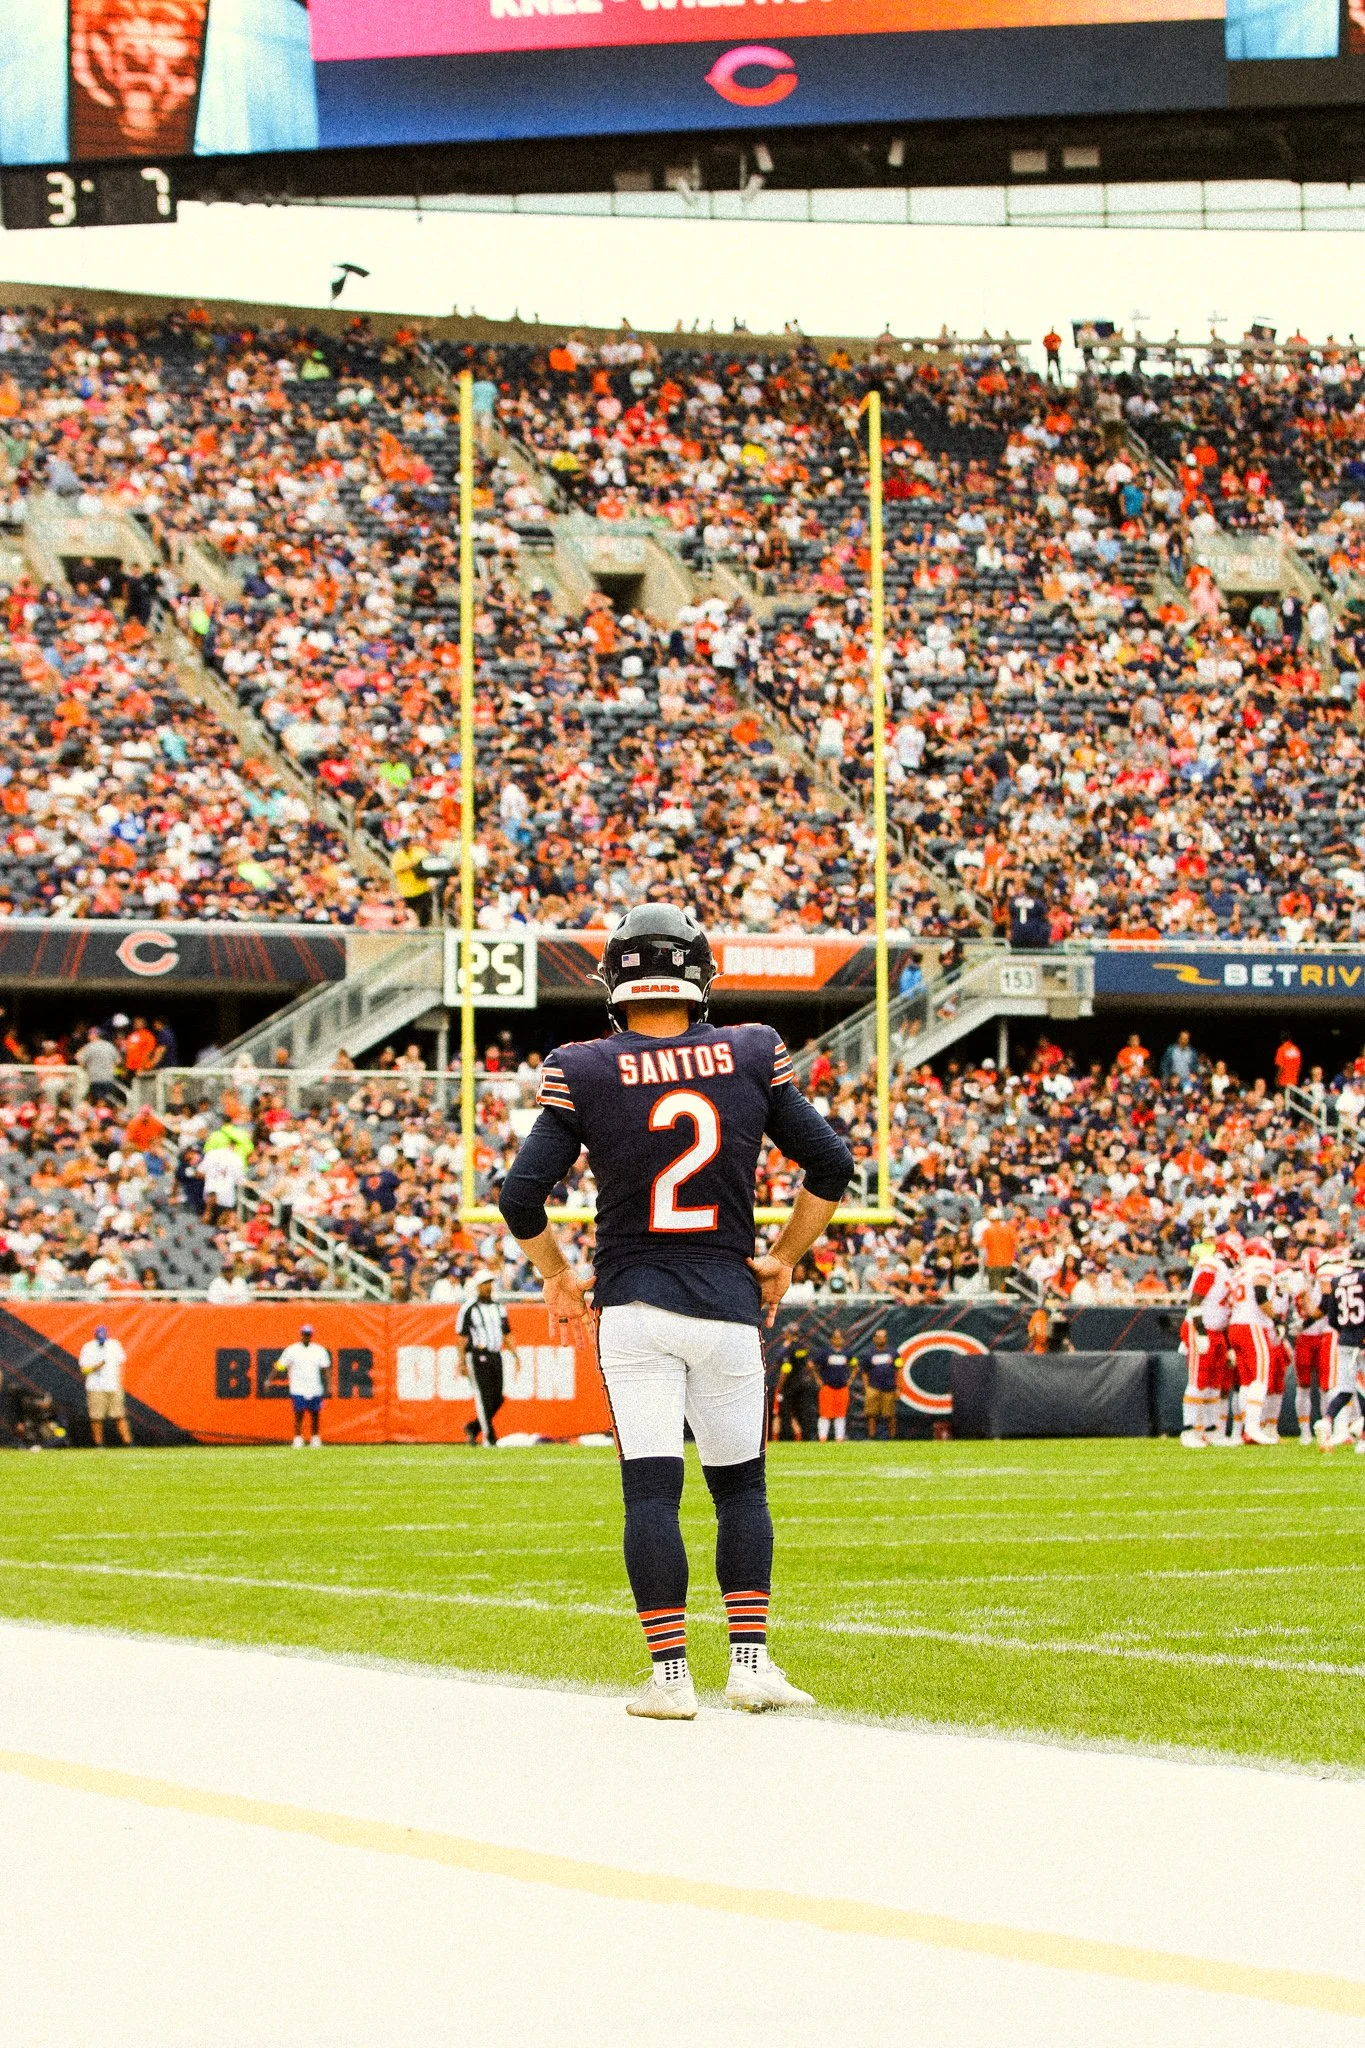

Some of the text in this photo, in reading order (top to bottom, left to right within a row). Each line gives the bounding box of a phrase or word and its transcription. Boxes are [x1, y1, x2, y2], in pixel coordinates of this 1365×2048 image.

[47, 171, 76, 226] 3
[141, 167, 170, 216] 7
[457, 943, 523, 995] 25
[631, 984, 680, 994] BEARS
[1005, 970, 1033, 989] 153
[617, 1041, 735, 1086] SANTOS
[648, 1087, 722, 1234] 2
[1334, 1284, 1365, 1326] 35
[216, 1348, 374, 1399] BER
